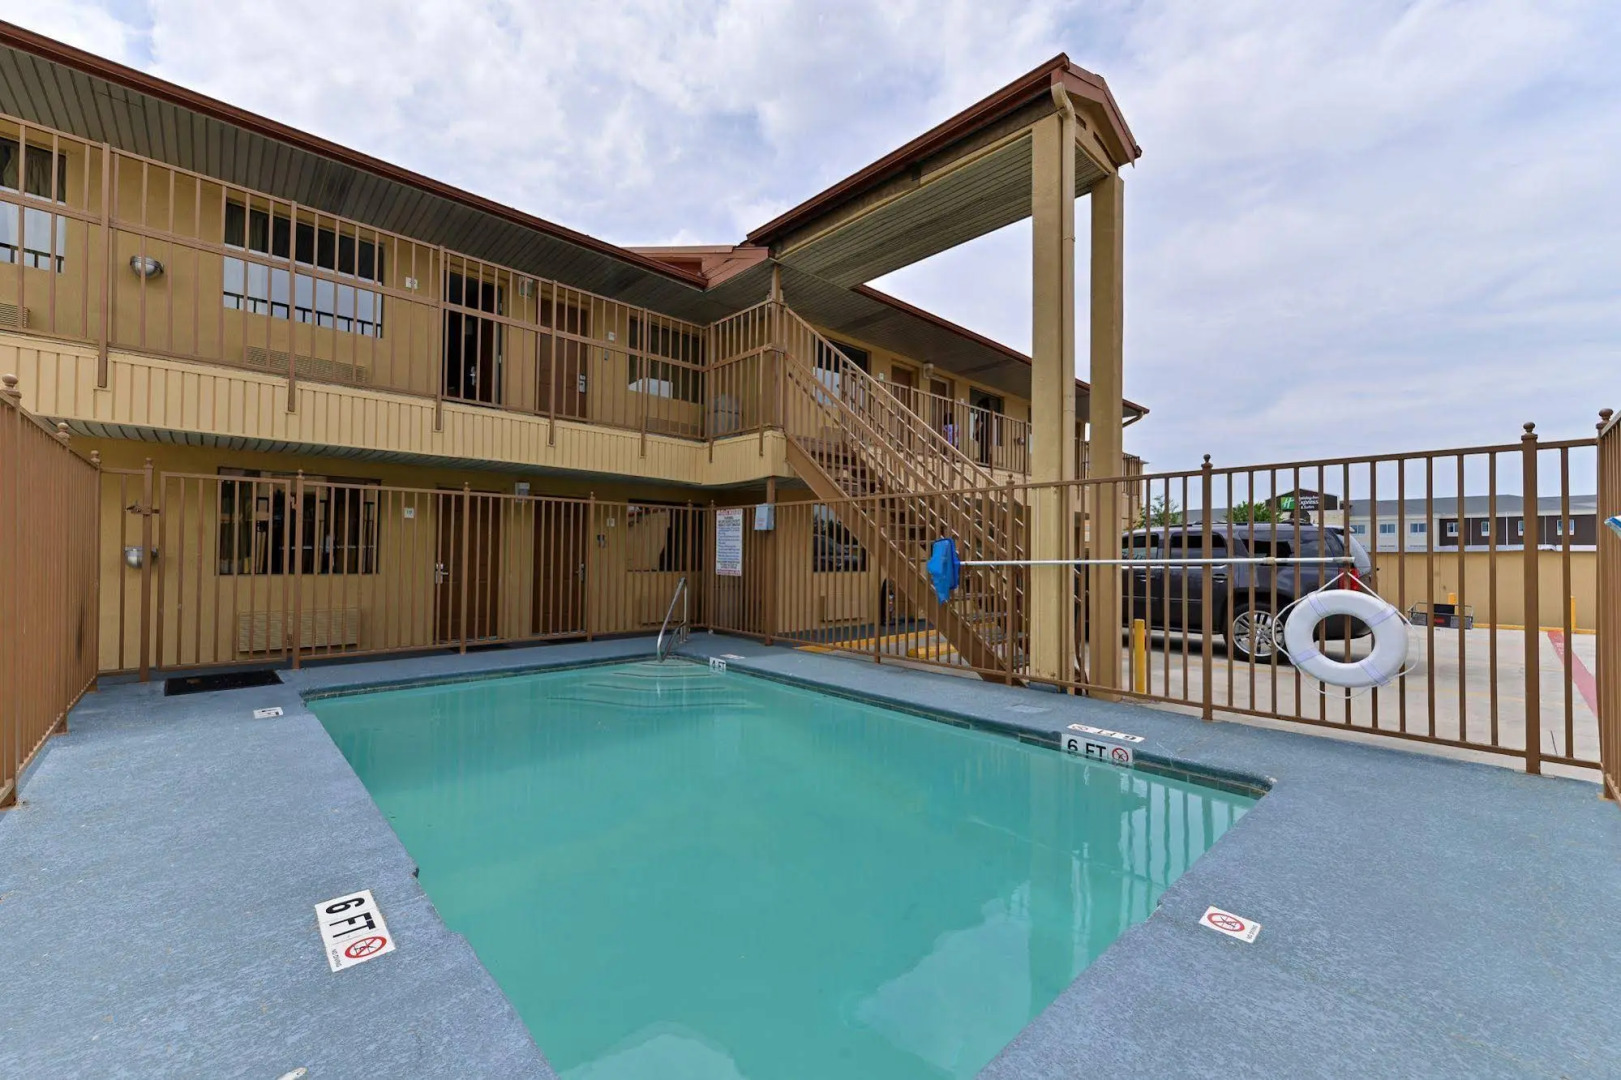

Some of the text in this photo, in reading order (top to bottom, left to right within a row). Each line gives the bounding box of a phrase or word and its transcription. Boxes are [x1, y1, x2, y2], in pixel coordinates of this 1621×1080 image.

[1068, 739, 1106, 757] 6 FT
[325, 897, 376, 938] 6 FT
